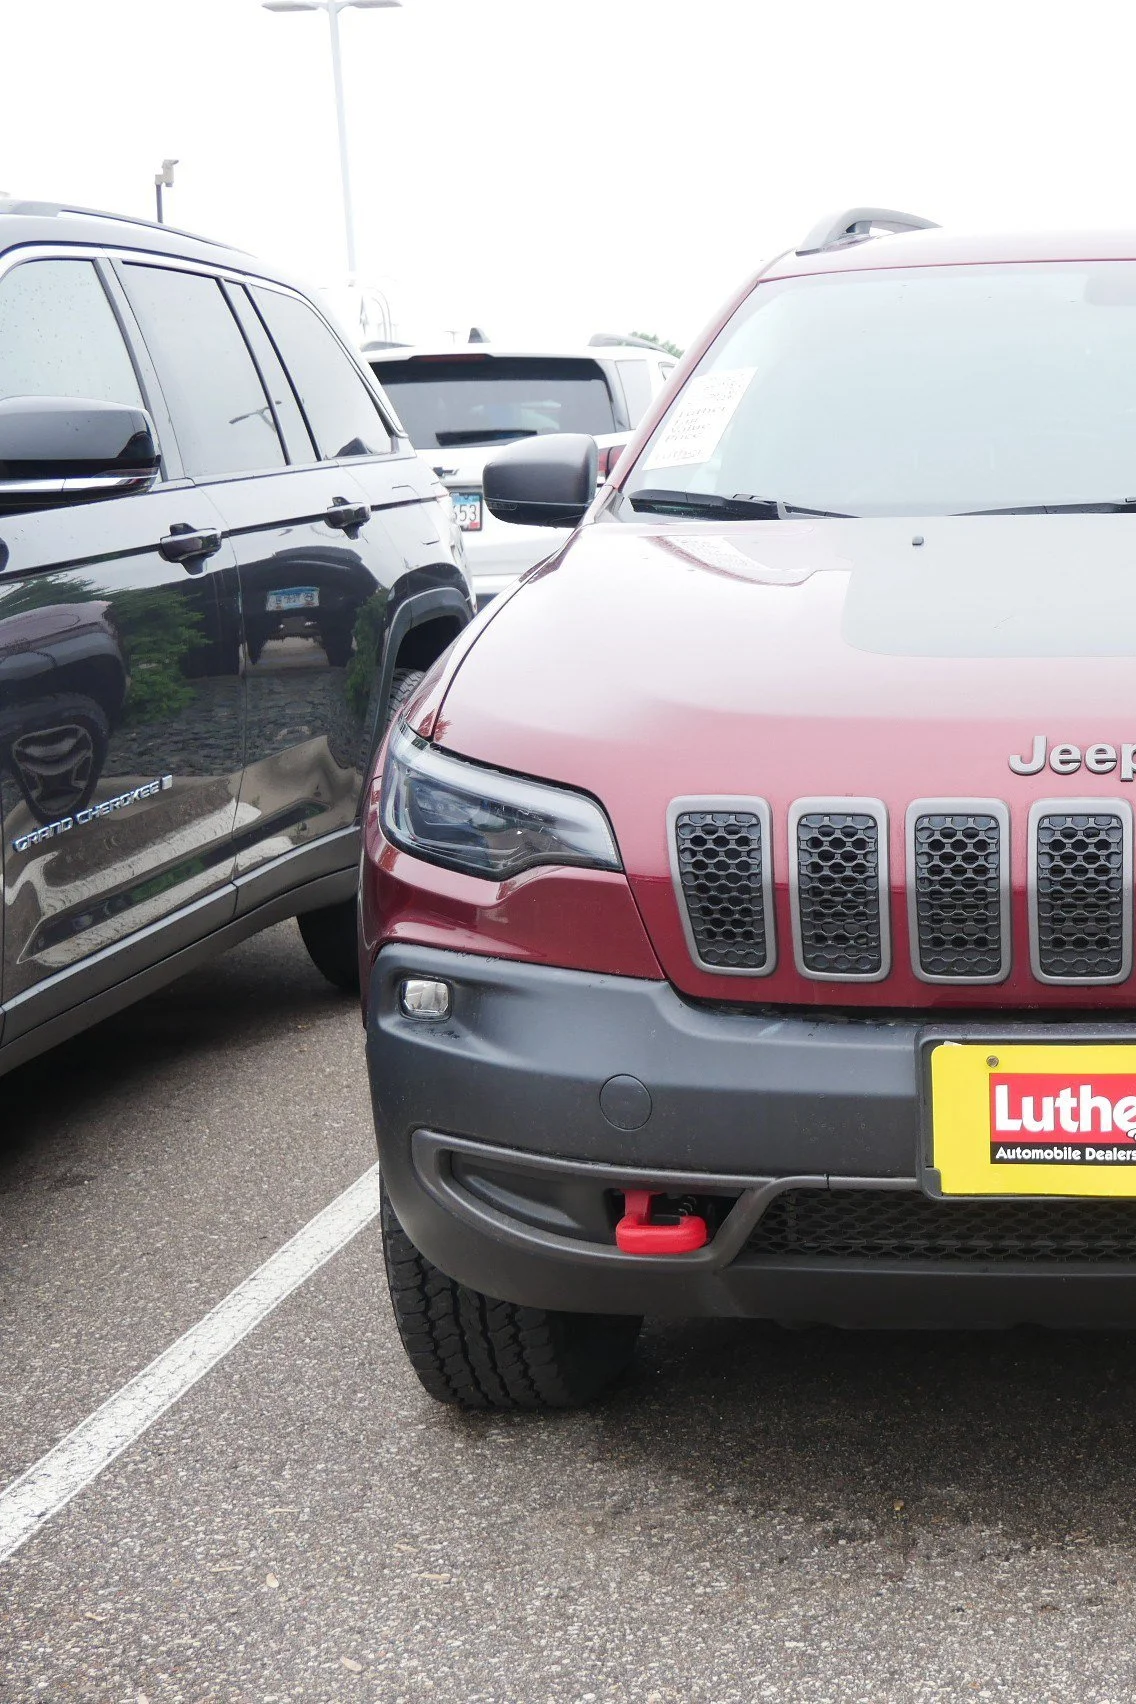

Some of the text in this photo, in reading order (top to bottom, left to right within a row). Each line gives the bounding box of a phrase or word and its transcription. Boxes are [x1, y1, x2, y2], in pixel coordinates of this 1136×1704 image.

[12, 780, 161, 852] GRAND CHEROKEE
[995, 1146, 1081, 1161] Automobile
